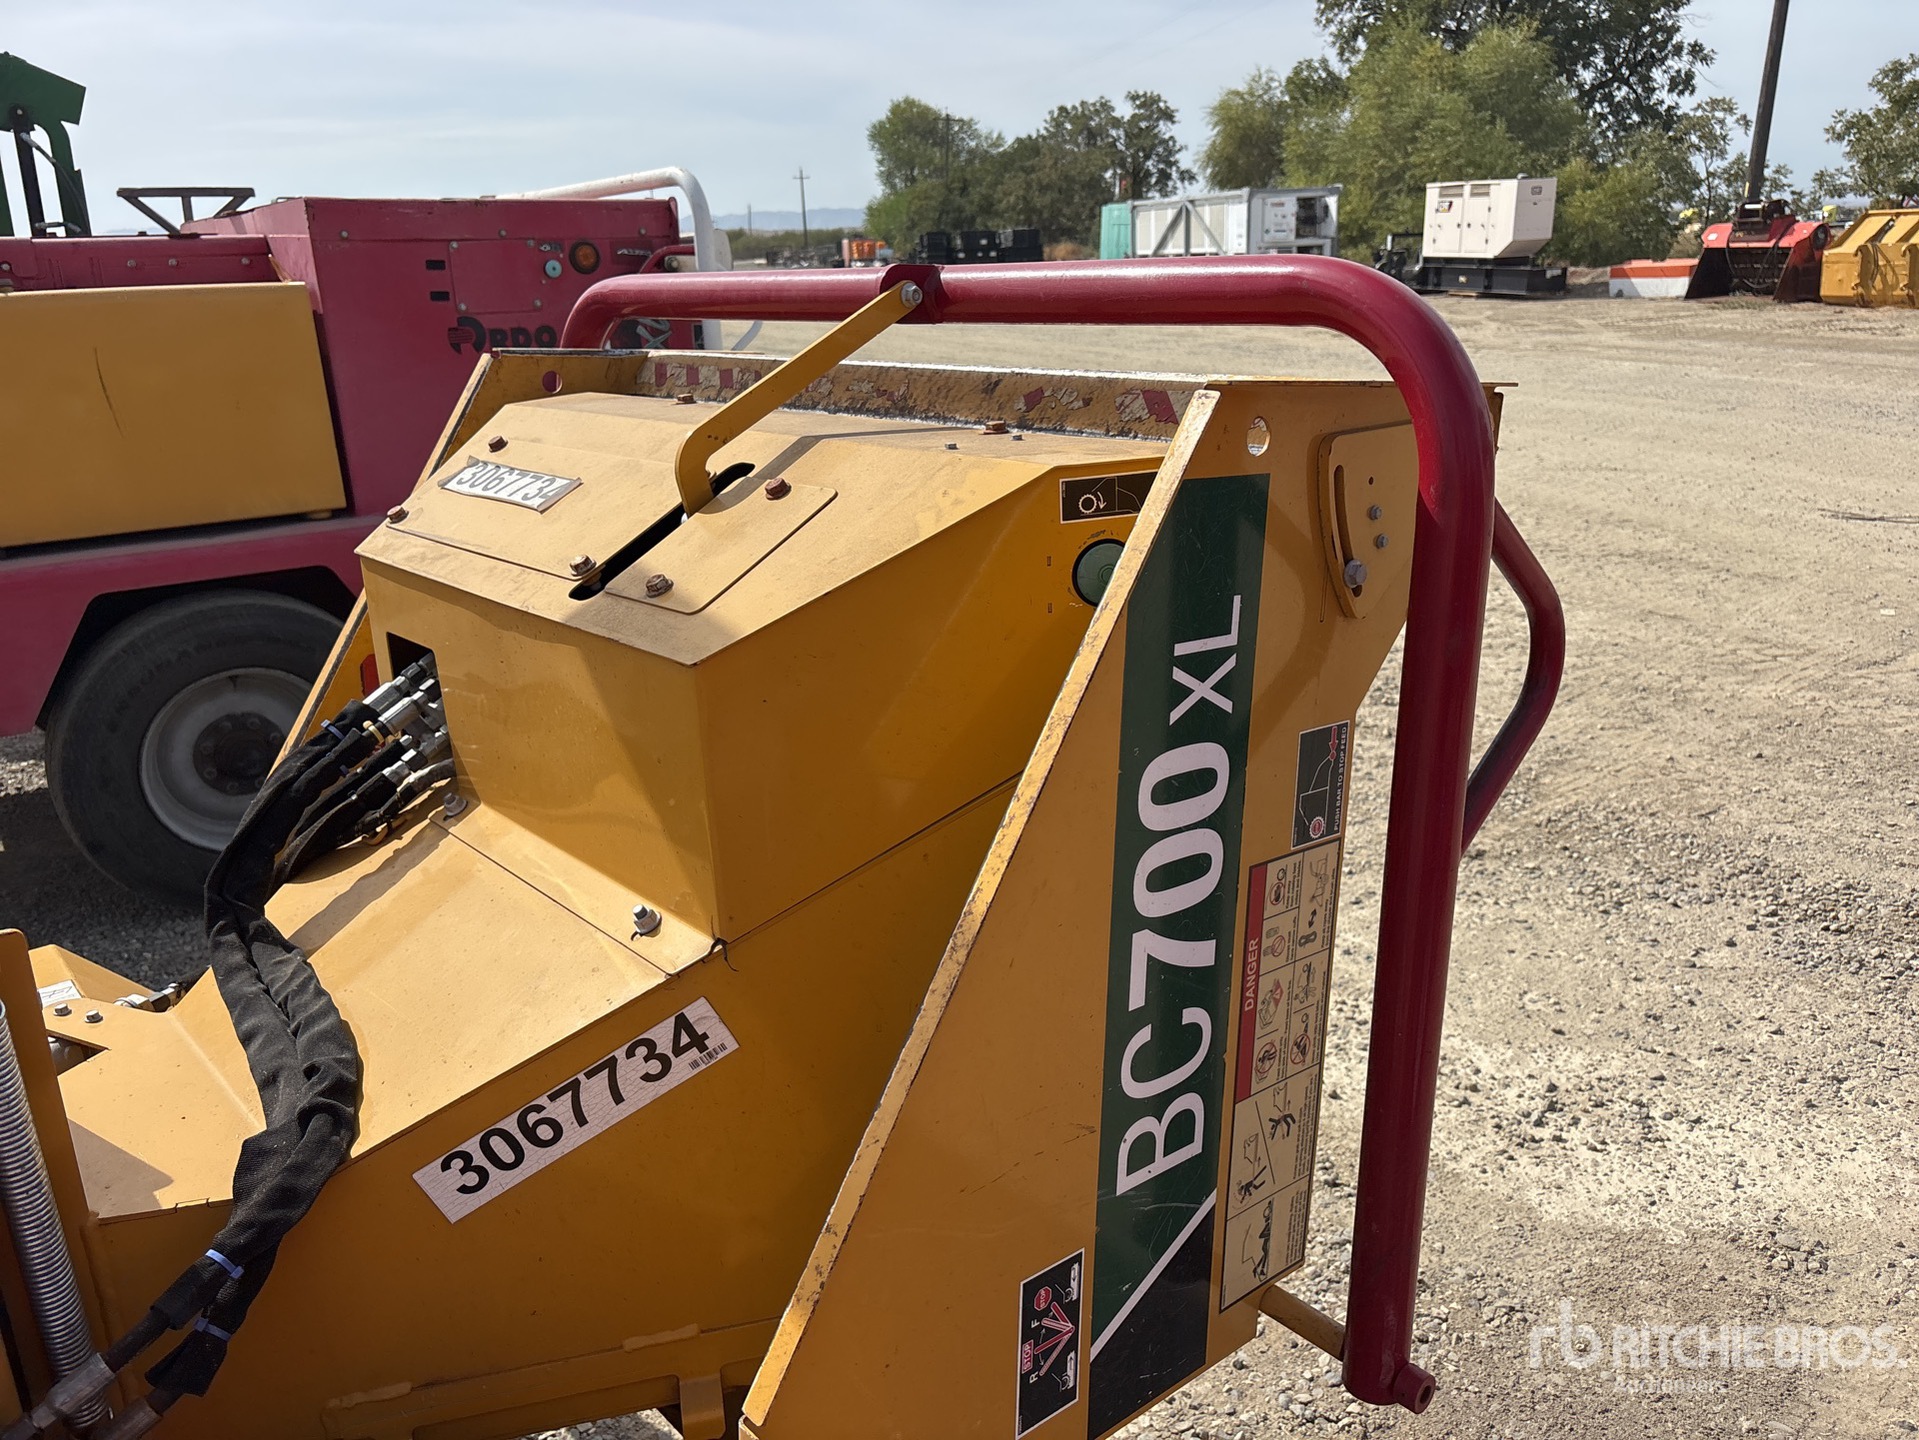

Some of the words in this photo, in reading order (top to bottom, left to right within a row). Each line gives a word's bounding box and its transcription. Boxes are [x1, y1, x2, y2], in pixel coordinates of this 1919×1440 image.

[1169, 594, 1242, 726] XL
[1338, 775, 1343, 787] TO
[1116, 741, 1230, 1196] BC700
[1244, 937, 1260, 1012] DANGER
[440, 1012, 710, 1194] 3067734
[1039, 1288, 1047, 1308] STOP
[1031, 1318, 1040, 1328] F
[1023, 1343, 1031, 1371] STOP
[1029, 1371, 1039, 1384] R
